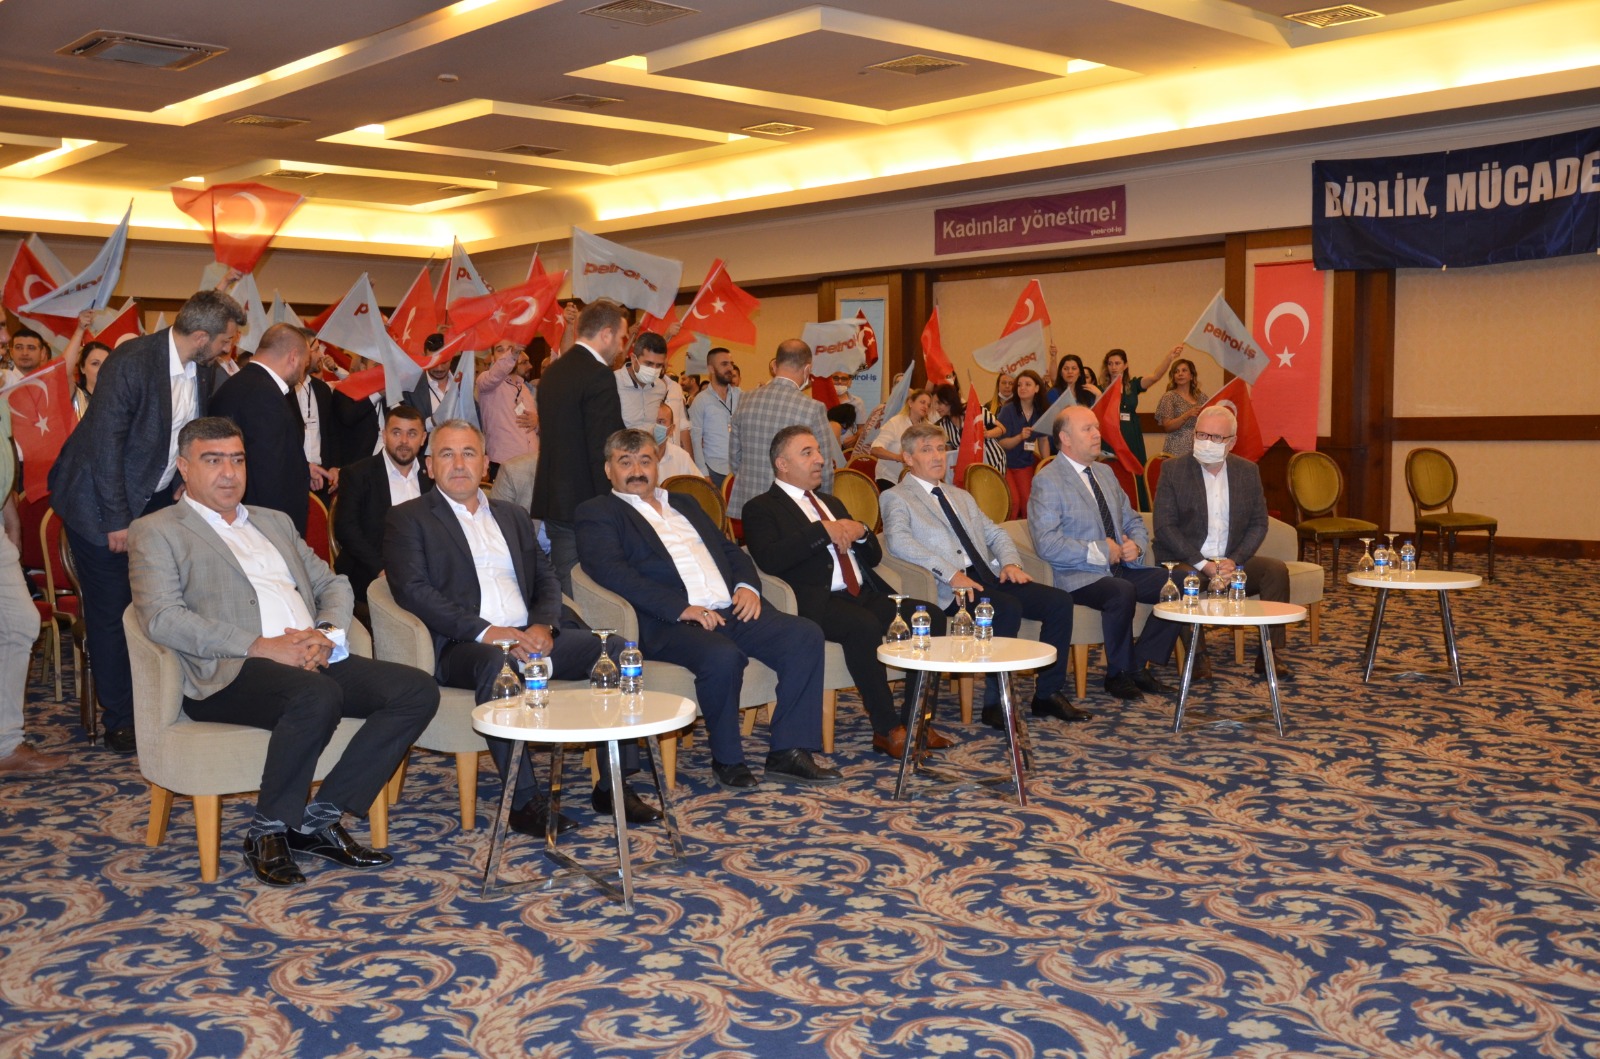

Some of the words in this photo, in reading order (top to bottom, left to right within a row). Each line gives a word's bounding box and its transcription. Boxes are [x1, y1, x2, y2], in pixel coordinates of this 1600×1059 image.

[1324, 172, 1437, 219] BİRLİK,
[943, 215, 1017, 239] Kadınlar
[1021, 200, 1117, 235] yönetime!
